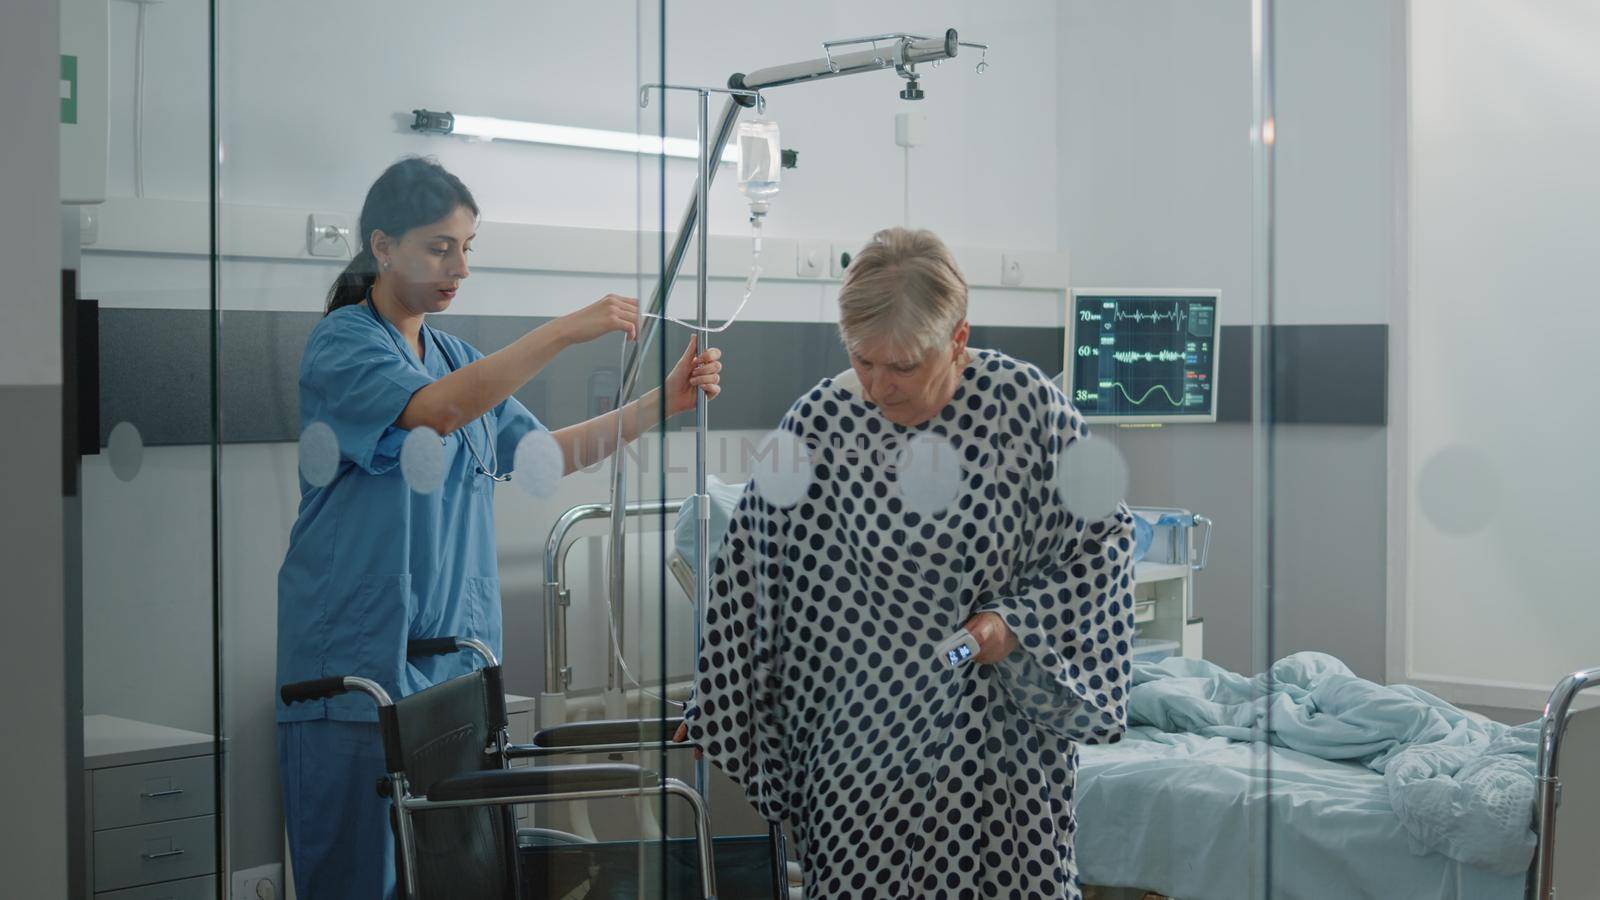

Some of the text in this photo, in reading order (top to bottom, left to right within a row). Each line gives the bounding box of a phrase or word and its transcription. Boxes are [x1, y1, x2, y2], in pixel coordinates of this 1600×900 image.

[1080, 310, 1091, 321] 70
[1078, 345, 1090, 356] 60
[1076, 390, 1088, 401] 38
